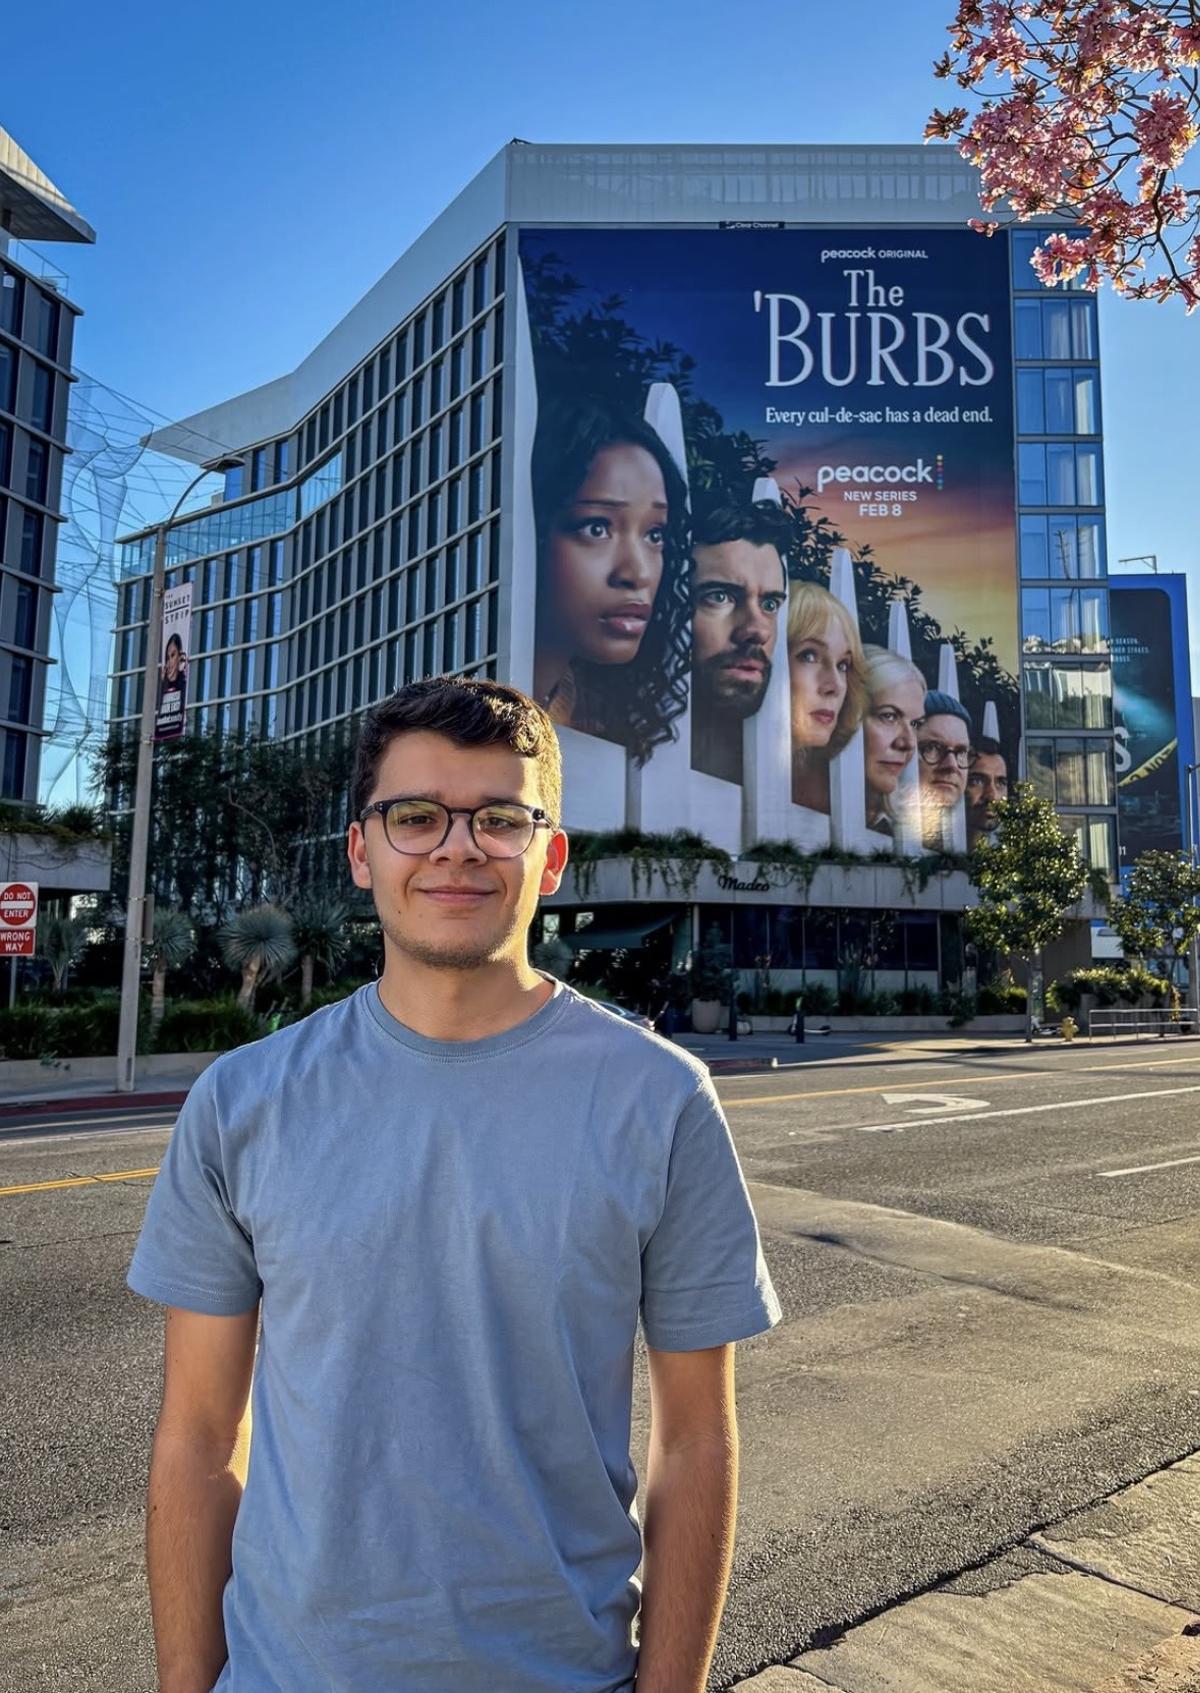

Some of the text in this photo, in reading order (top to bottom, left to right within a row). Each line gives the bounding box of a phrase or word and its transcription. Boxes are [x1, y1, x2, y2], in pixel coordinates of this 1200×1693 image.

[821, 246, 928, 263] peacock ORIGINAL
[843, 269, 904, 307] The
[753, 290, 994, 387] 'BURBS
[766, 406, 993, 427] Every cul-de-sac has a dead end.
[817, 458, 934, 493] peacock
[844, 491, 917, 501] NEW SERIES
[859, 503, 902, 516] FEB 8
[165, 594, 190, 610] SUNSET
[165, 609, 189, 624] STRIP
[4, 892, 31, 900] DO NOT
[4, 910, 29, 918] ENTER
[0, 931, 30, 942] WRONG
[5, 942, 24, 951] WAY
